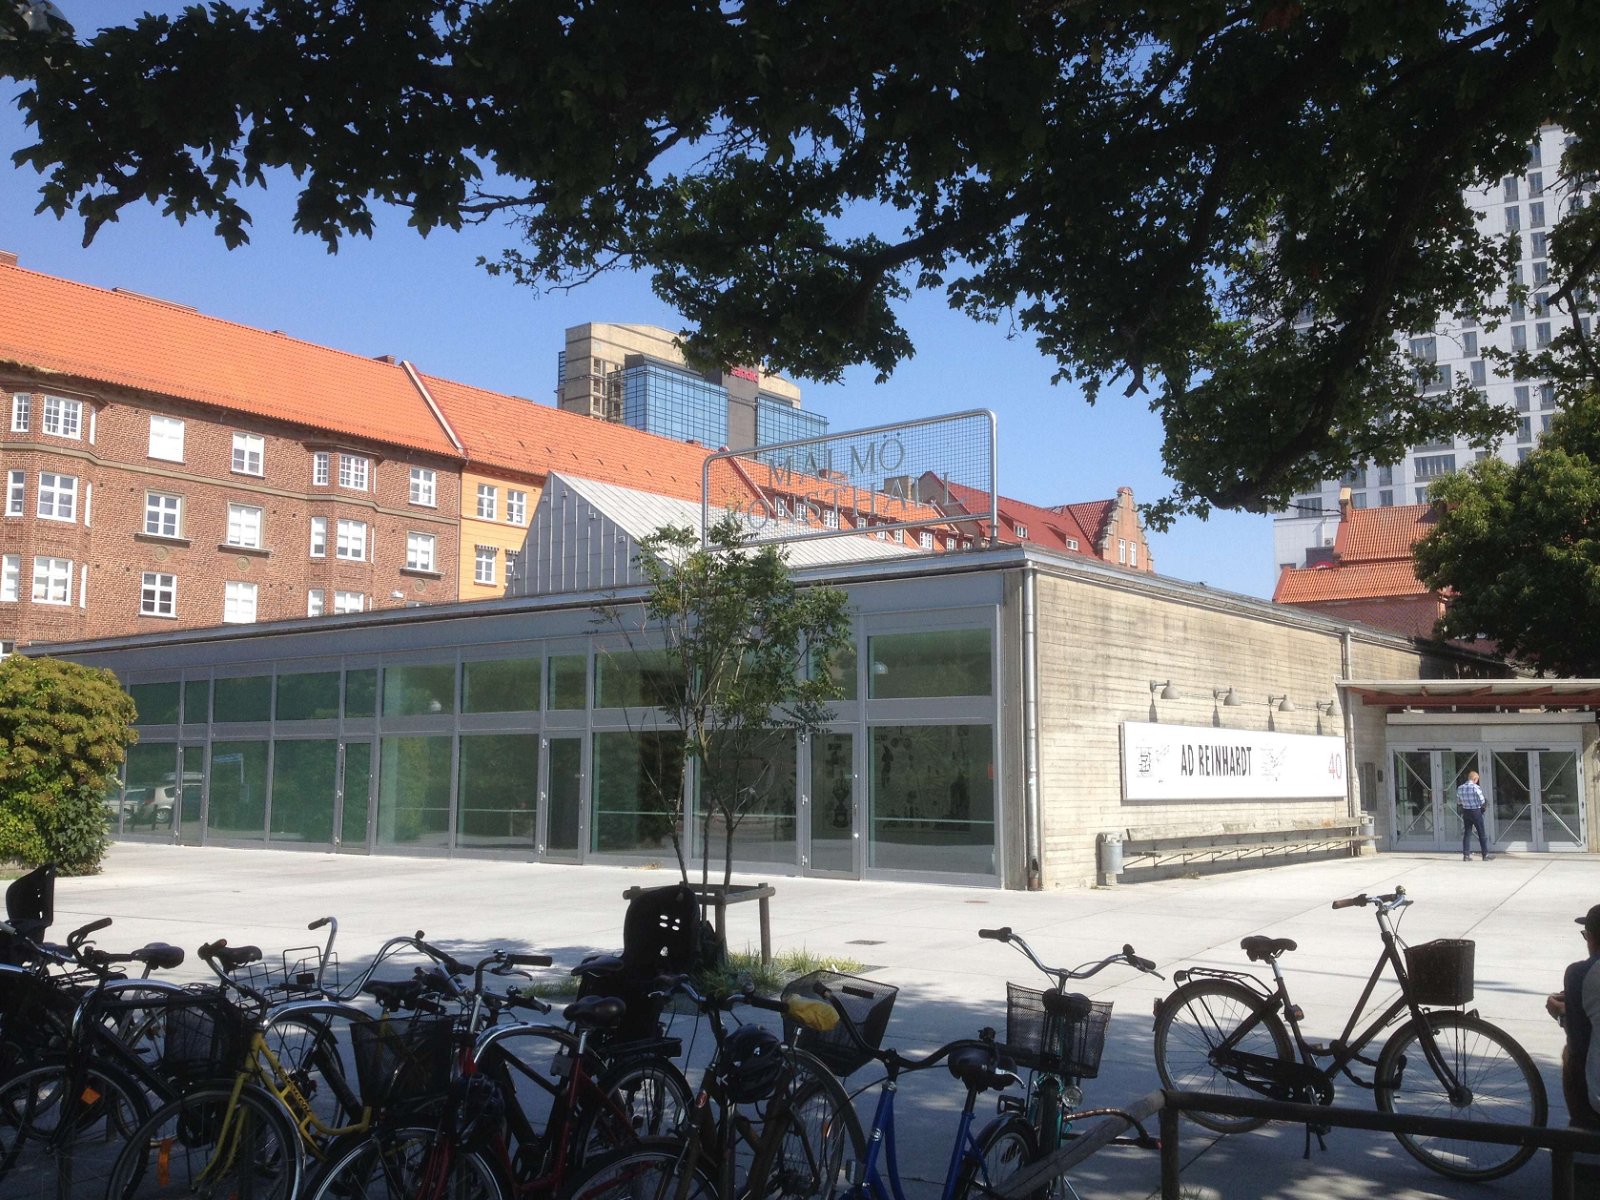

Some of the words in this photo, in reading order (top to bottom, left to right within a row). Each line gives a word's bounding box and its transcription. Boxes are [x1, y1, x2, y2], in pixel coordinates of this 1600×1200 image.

[768, 431, 905, 489] MALMÖ
[1181, 744, 1194, 776] AD
[1198, 744, 1252, 776] REINHARDT
[1328, 752, 1342, 779] 40
